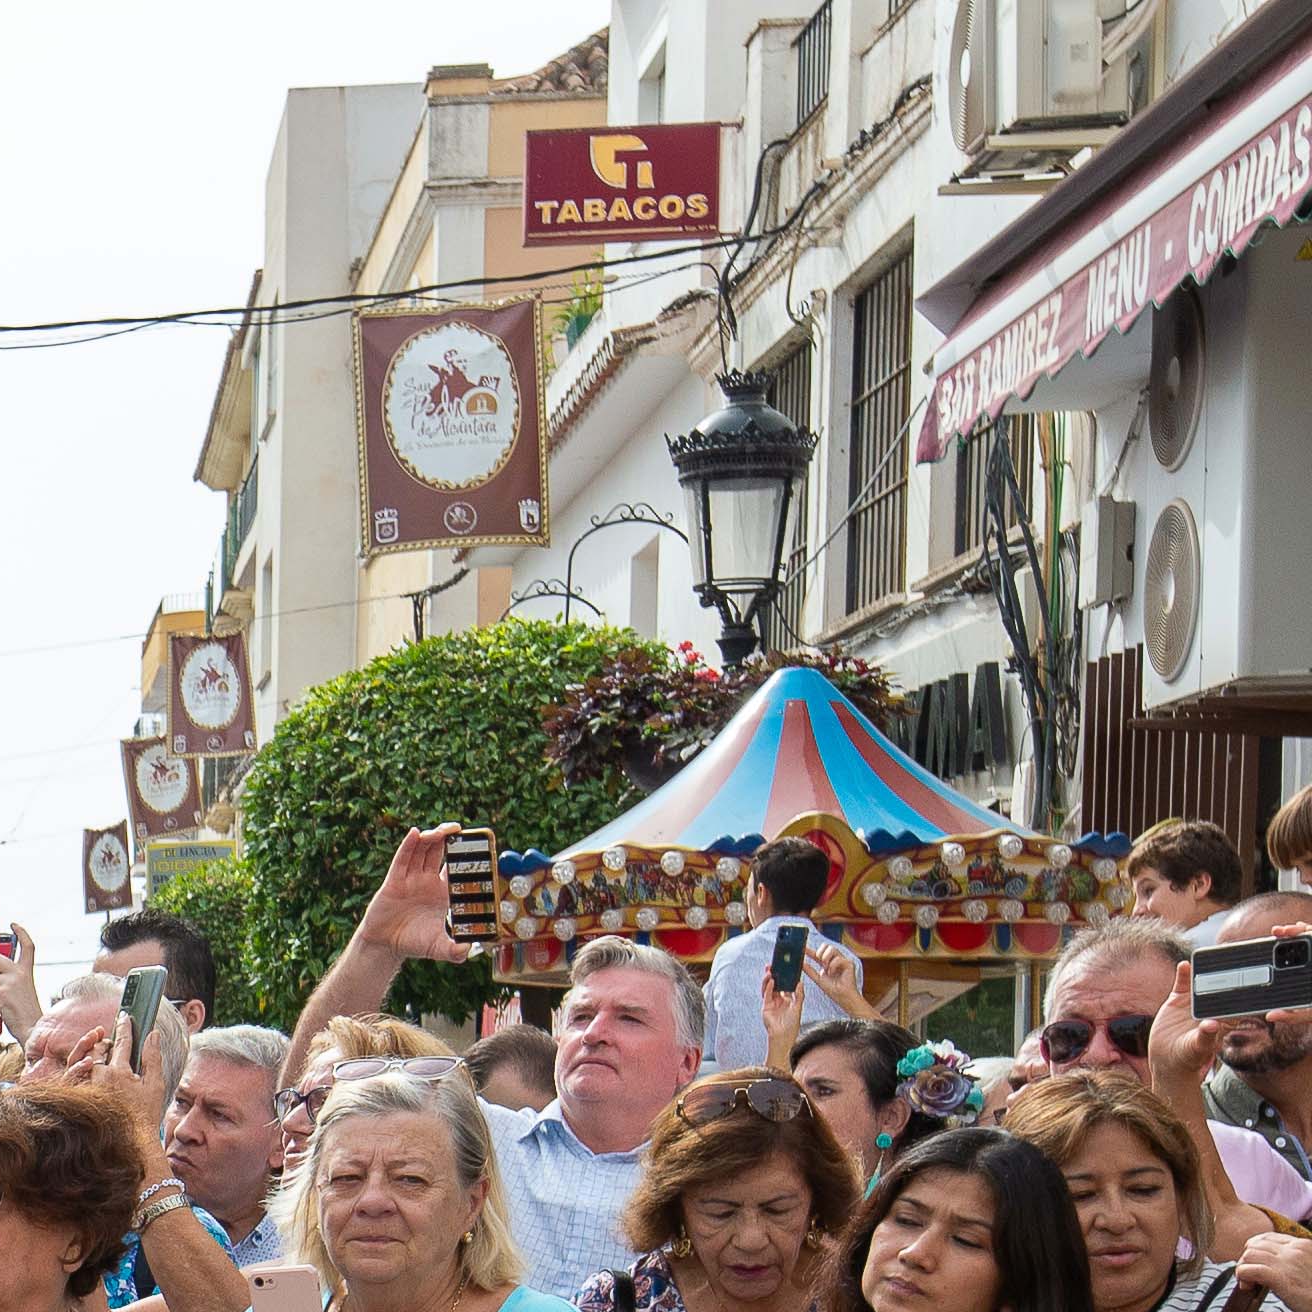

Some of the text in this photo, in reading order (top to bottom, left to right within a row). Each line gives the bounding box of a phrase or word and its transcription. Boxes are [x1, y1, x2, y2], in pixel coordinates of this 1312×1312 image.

[534, 193, 709, 224] TABACOS
[977, 291, 1062, 411] RAMIREZ
[1084, 225, 1151, 341] MENU
[1187, 105, 1312, 267] COMIDAS
